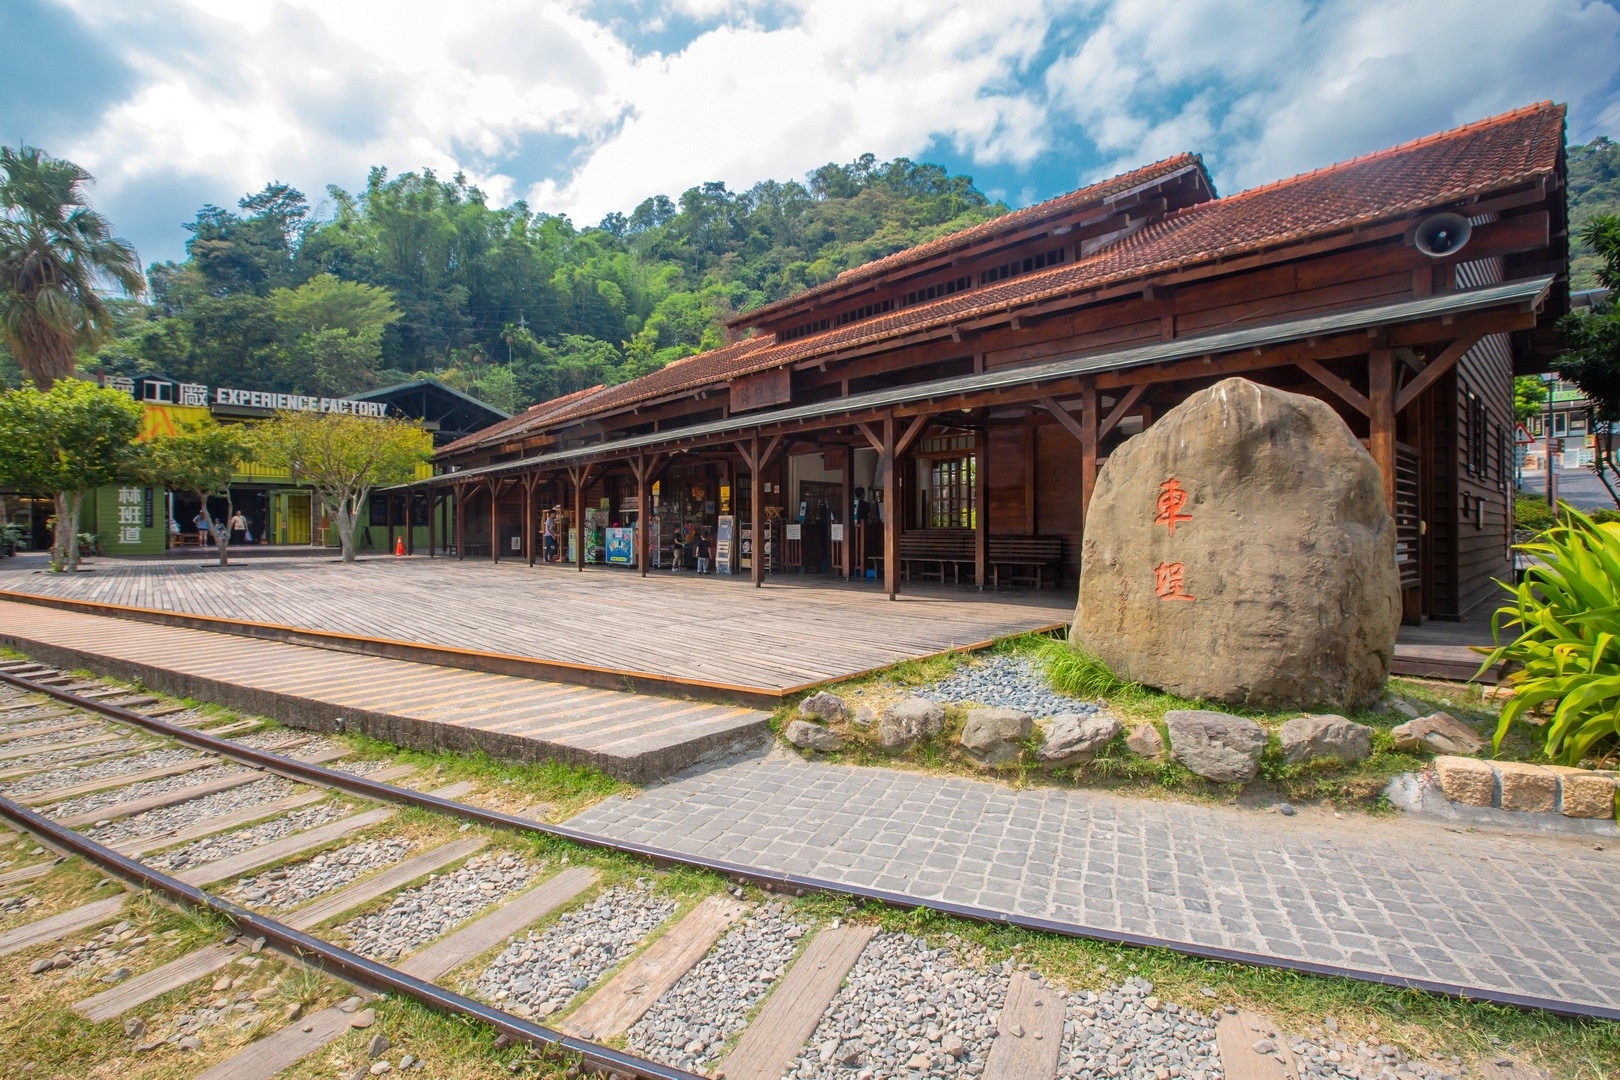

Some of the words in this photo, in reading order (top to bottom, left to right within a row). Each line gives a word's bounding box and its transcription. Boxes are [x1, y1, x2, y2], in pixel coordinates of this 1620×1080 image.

[217, 388, 318, 412] EXPERIENCE
[320, 397, 388, 418] FACTORY
[118, 486, 142, 544] 林班道
[1155, 479, 1195, 601] 車埕
